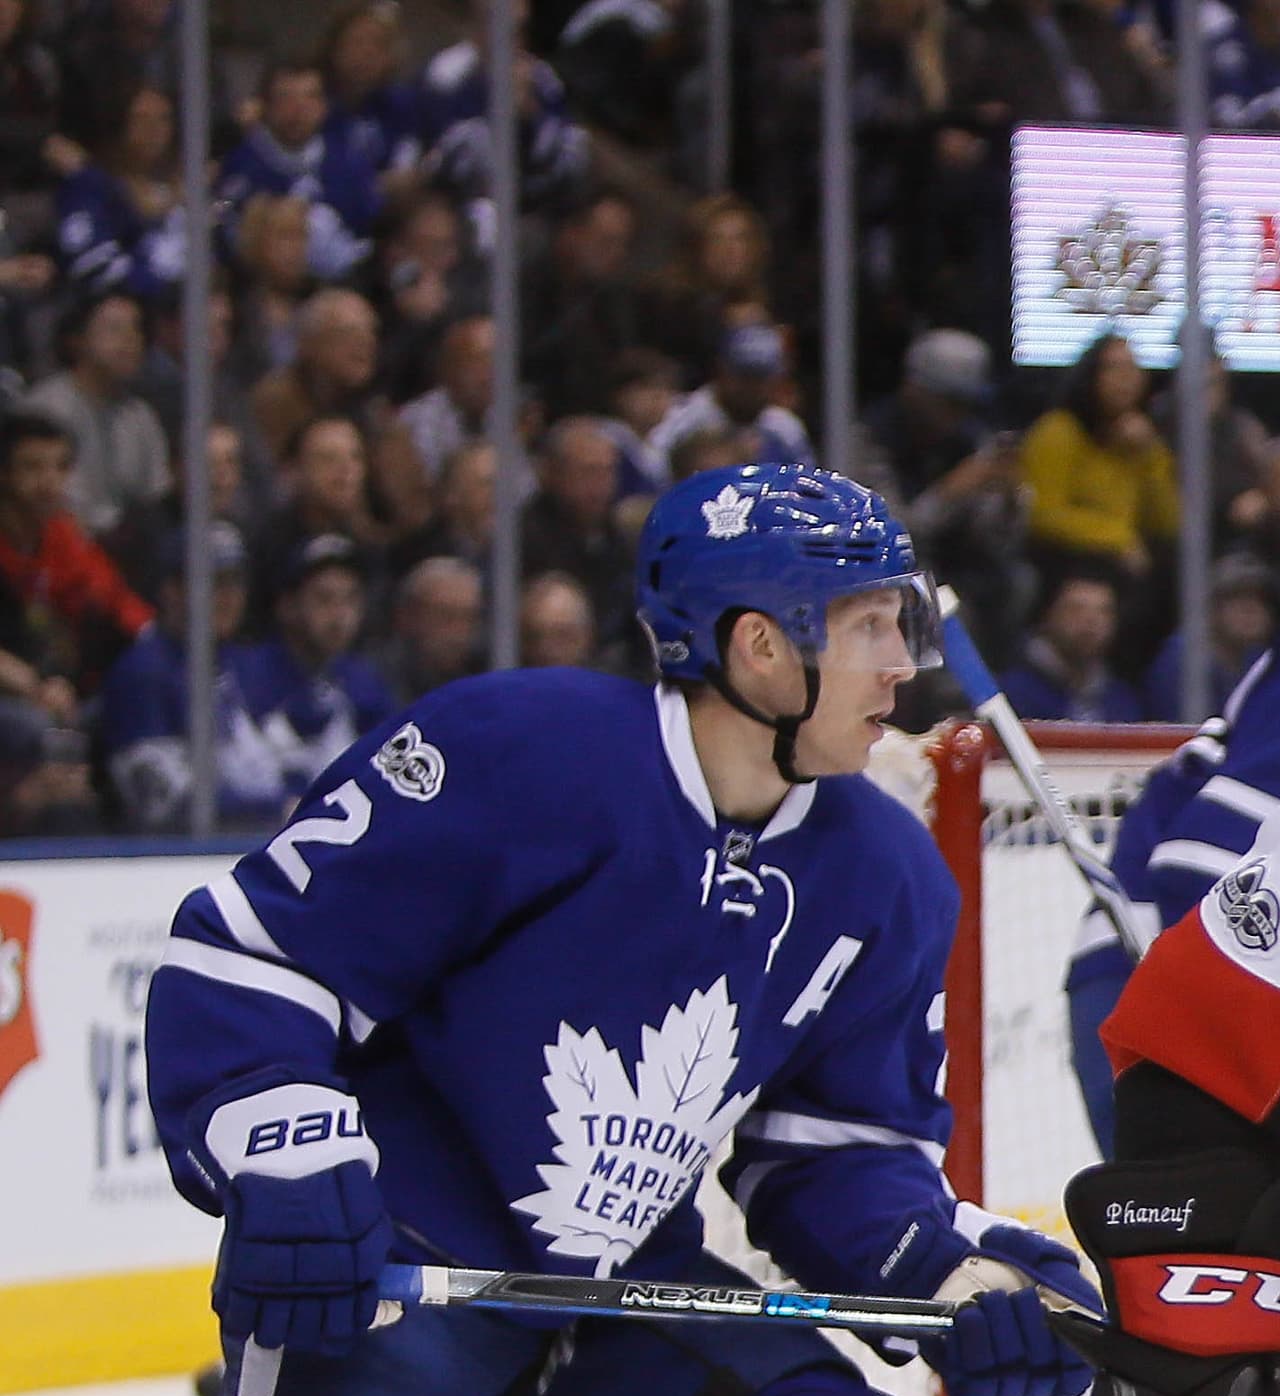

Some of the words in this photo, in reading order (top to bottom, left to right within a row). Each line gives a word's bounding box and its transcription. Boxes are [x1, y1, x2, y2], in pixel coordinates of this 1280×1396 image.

[267, 779, 373, 894] 2
[782, 935, 864, 1027] A
[579, 1113, 711, 1178] TORONTO
[589, 1150, 688, 1202] MAPLE
[574, 1181, 670, 1230] LEAFS
[1106, 1198, 1195, 1232] Phaneuf
[620, 1284, 764, 1316] NEXUS
